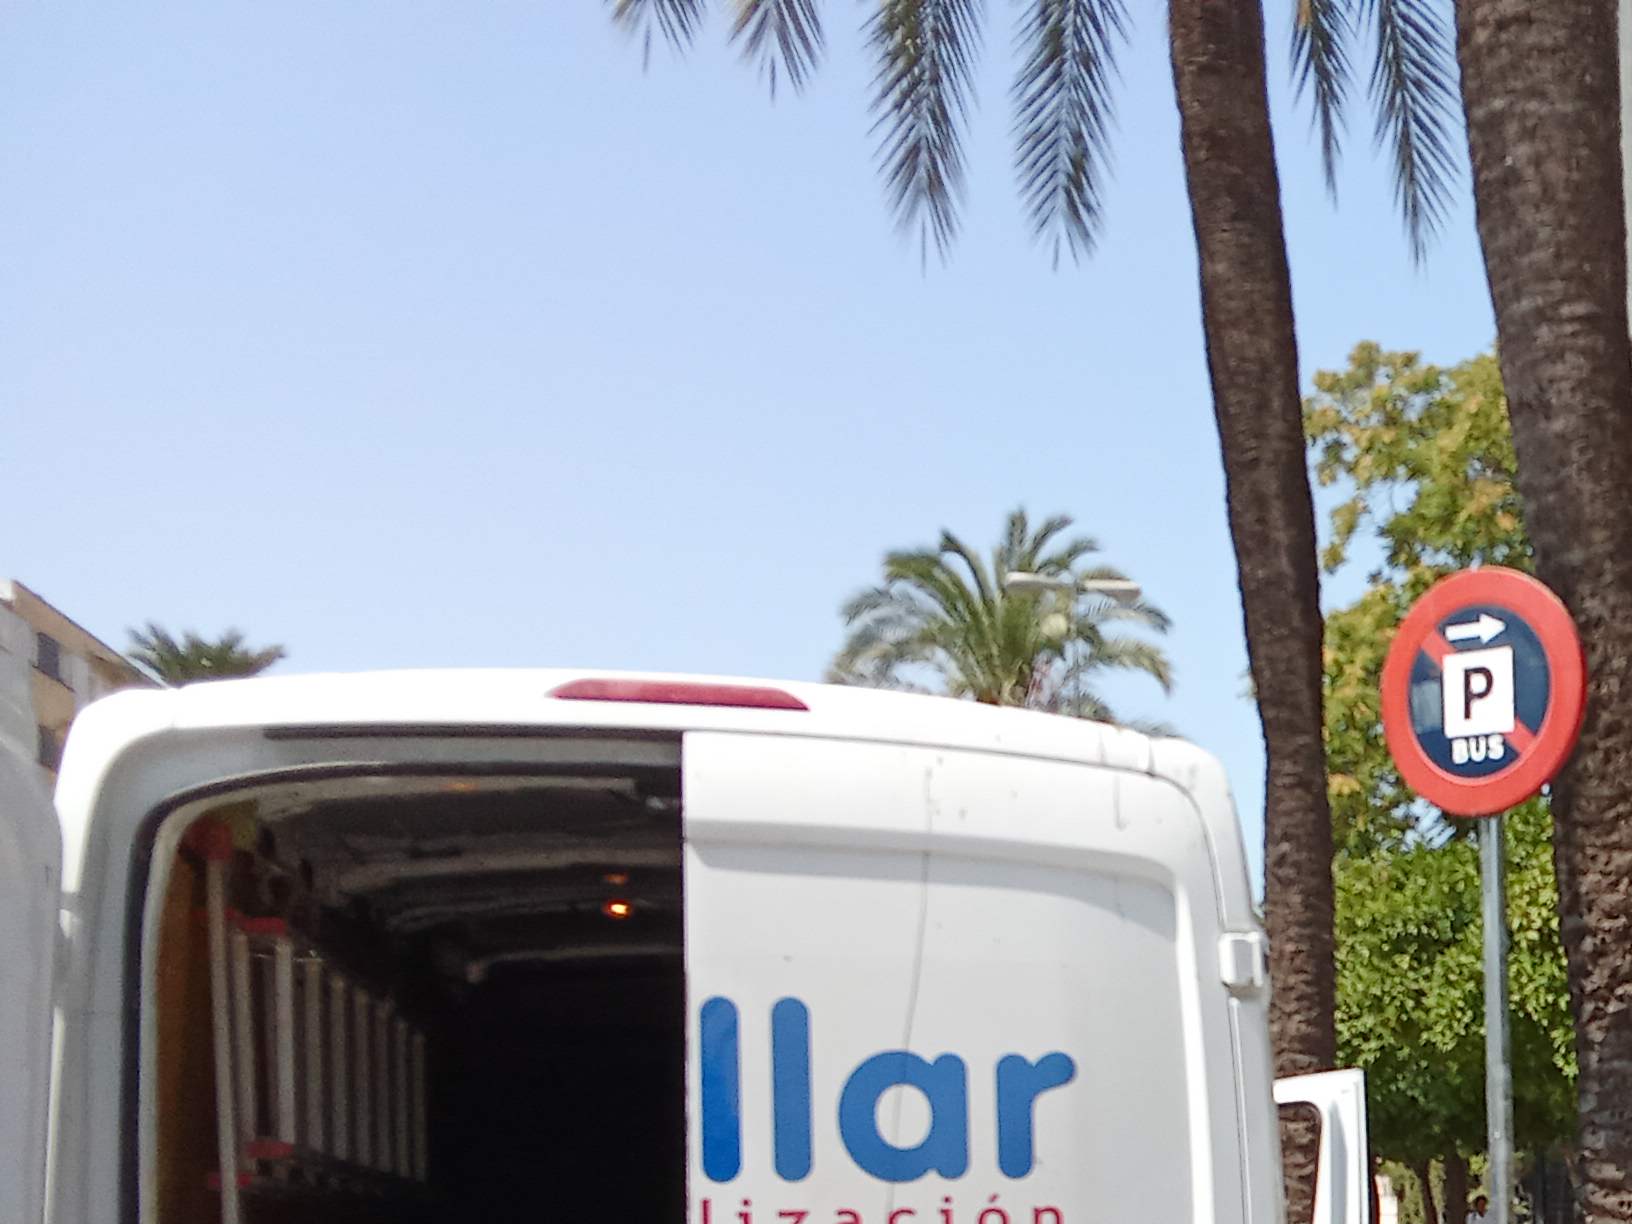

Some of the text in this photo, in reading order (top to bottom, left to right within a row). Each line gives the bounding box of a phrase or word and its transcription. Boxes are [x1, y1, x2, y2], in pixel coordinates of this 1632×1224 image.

[1464, 667, 1493, 719] P
[1452, 735, 1504, 764] BUS
[699, 996, 1077, 1183] llar
